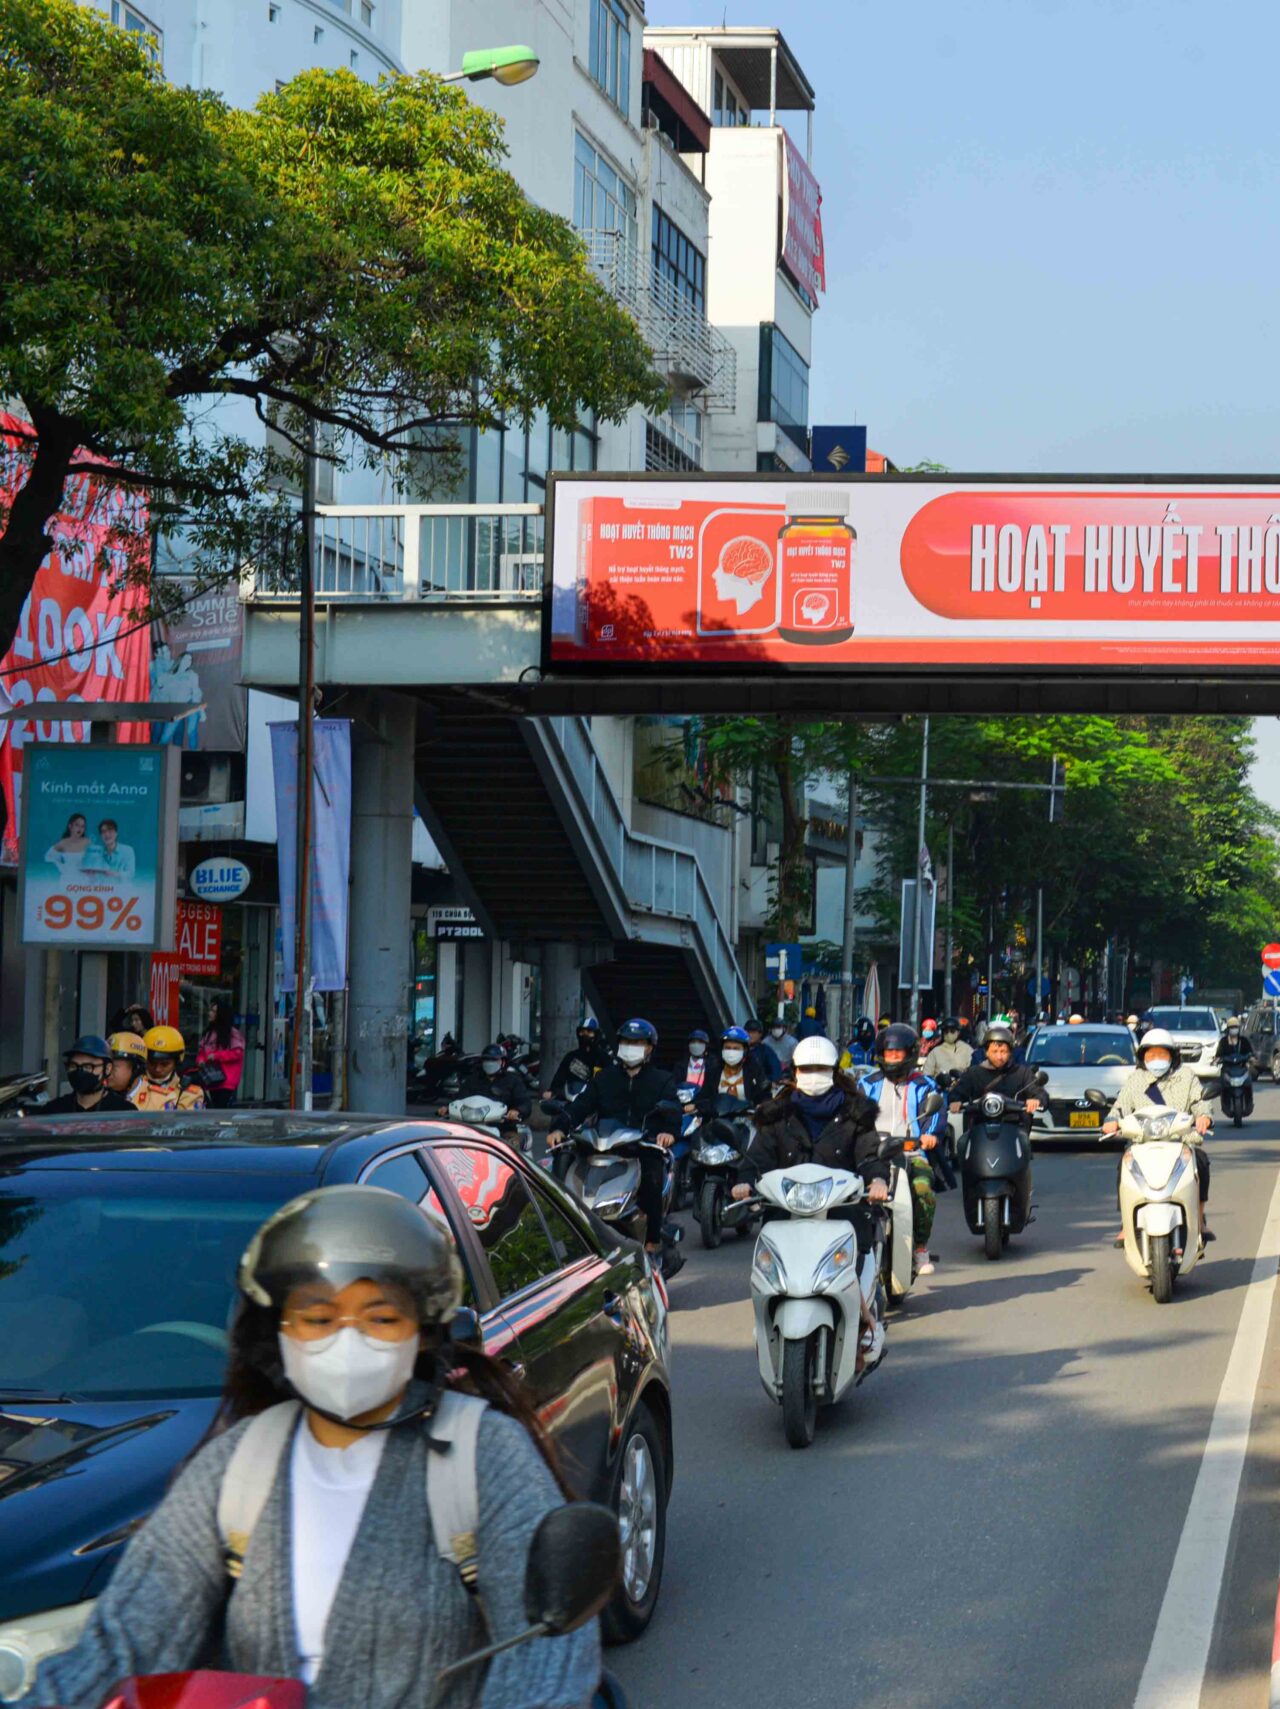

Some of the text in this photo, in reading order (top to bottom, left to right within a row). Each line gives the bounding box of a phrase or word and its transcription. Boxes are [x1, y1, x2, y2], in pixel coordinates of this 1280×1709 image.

[669, 545, 694, 560] TW3
[970, 524, 1071, 609] HOẠT
[1084, 502, 1203, 593] HUYẾT
[192, 608, 238, 628] Sale
[14, 591, 124, 680] 100K
[41, 780, 148, 796] Kính mắt Anna
[196, 867, 243, 884] BLUE
[198, 884, 240, 894] EXCHANGE
[44, 895, 142, 932] 99%
